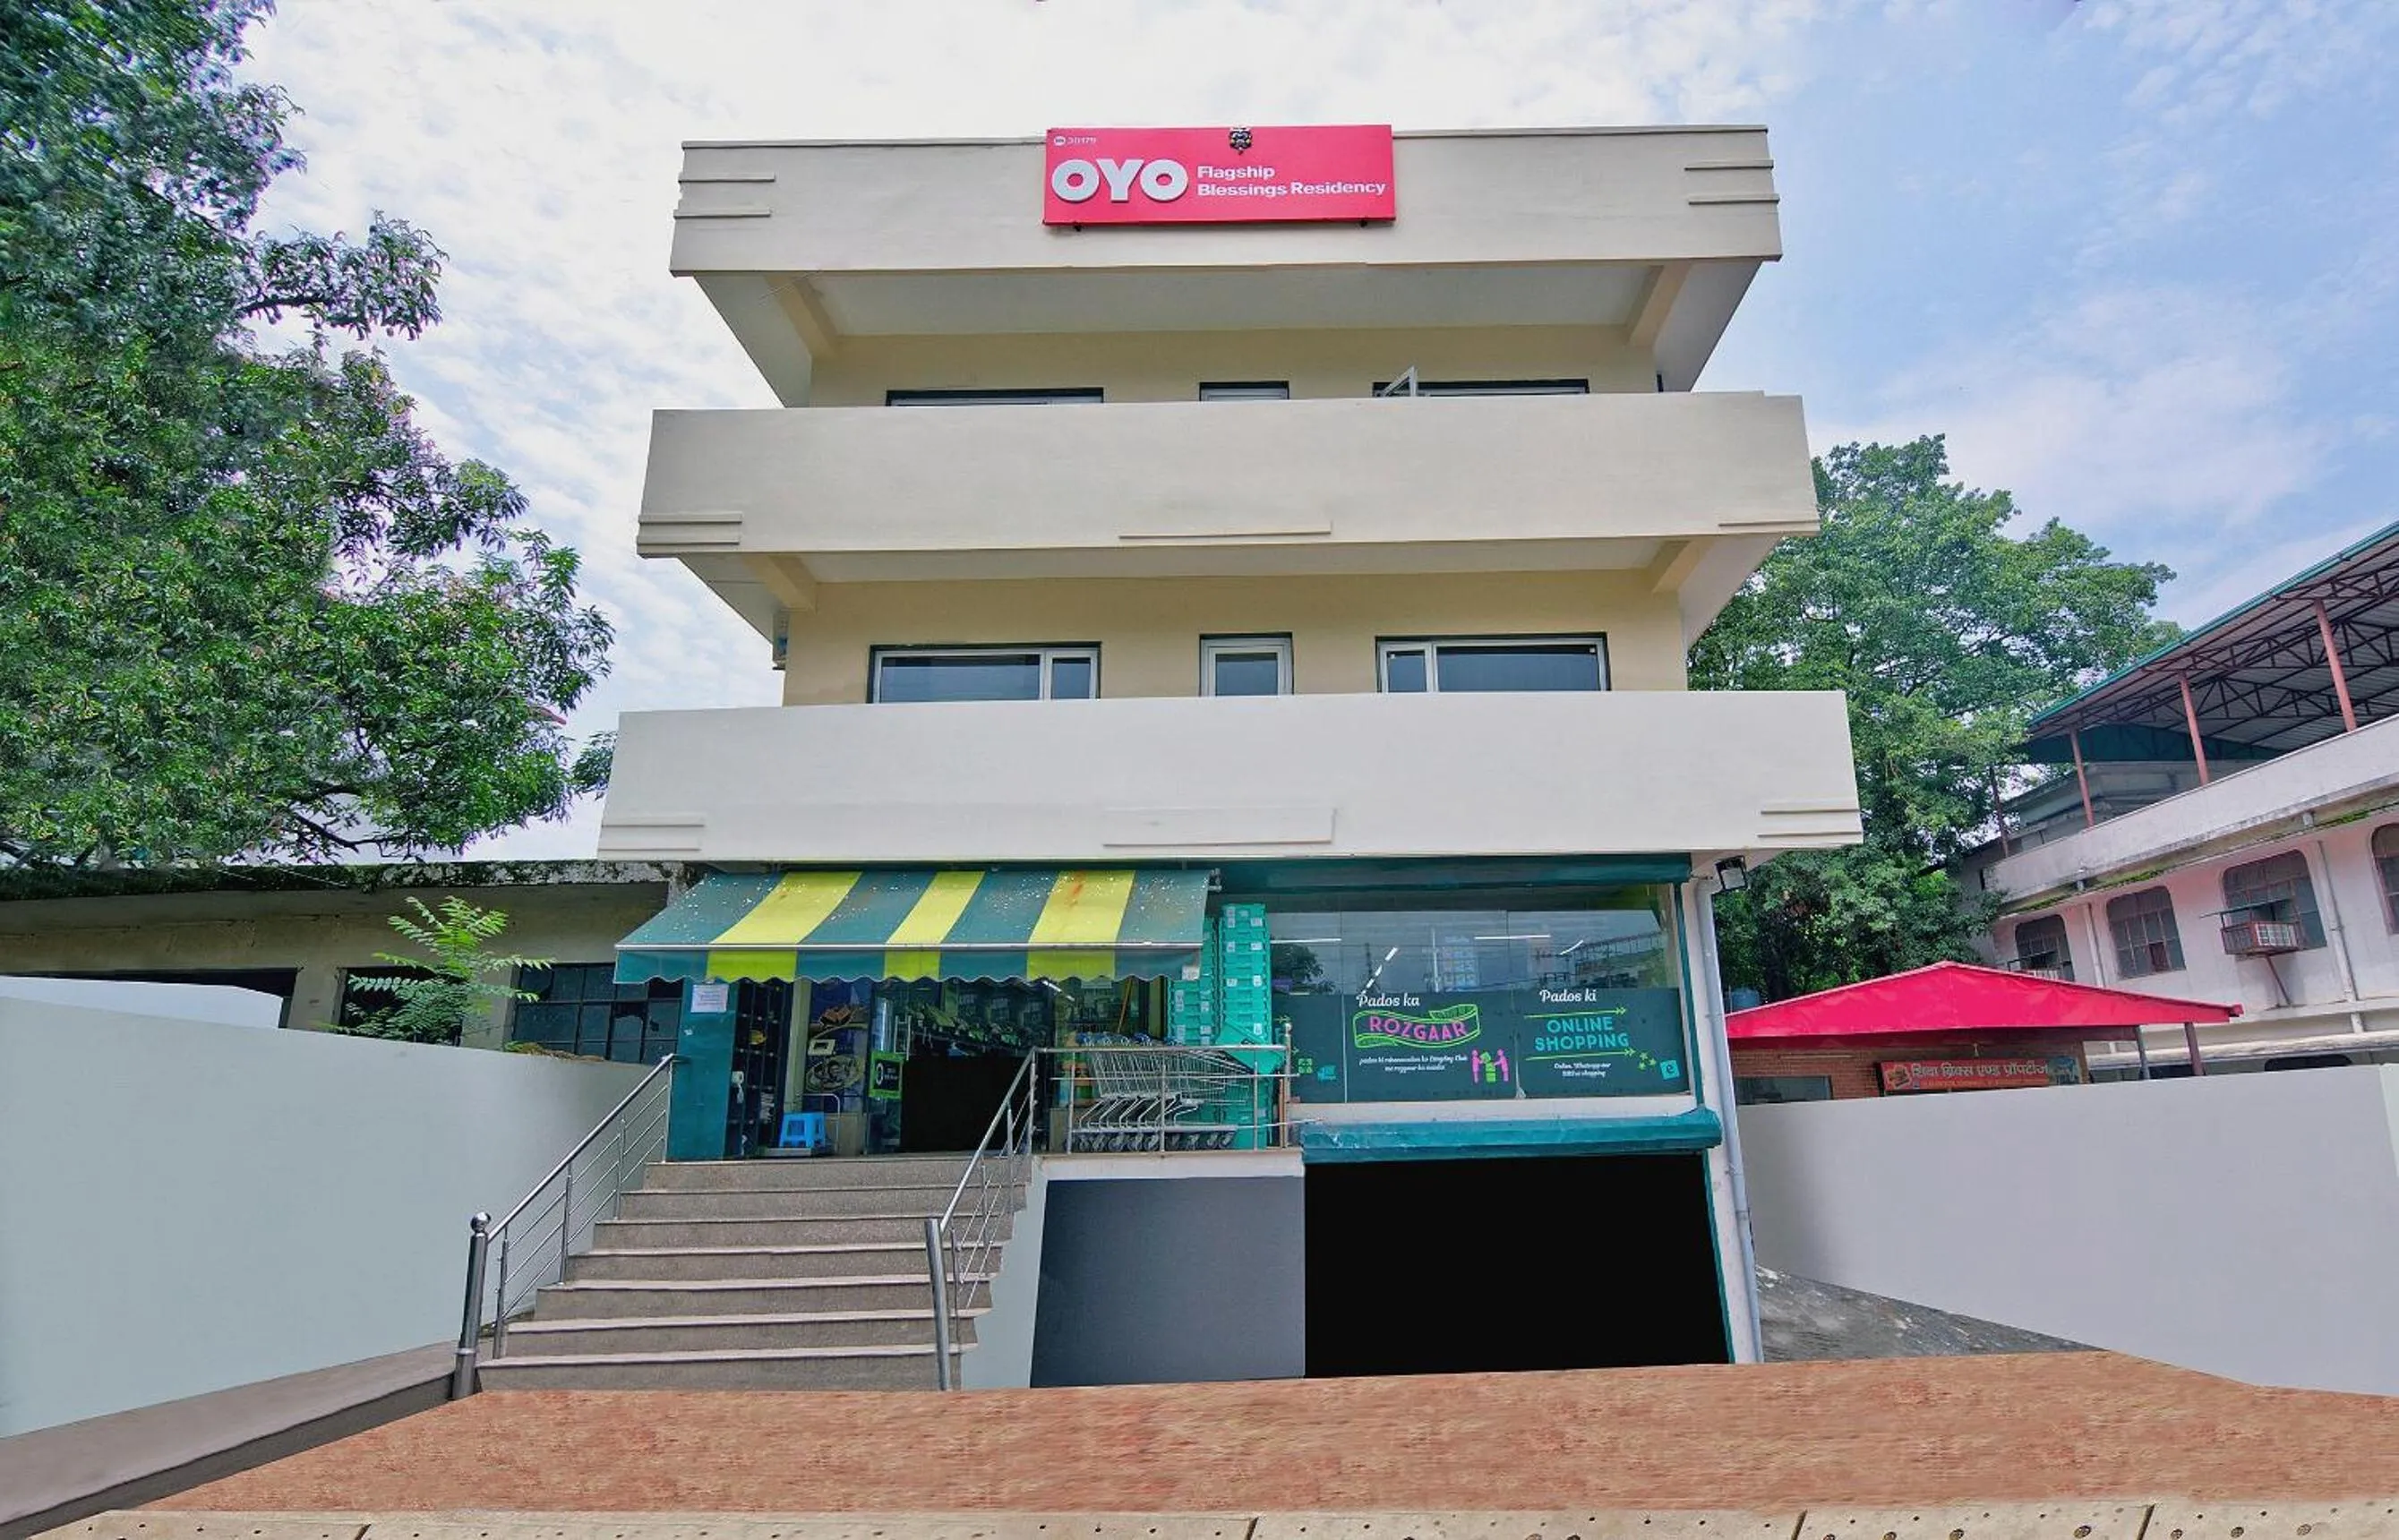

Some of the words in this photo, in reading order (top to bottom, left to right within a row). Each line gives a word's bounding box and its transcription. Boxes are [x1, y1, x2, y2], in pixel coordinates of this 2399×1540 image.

[1051, 158, 1189, 201] OYO
[1196, 166, 1275, 180] Flagship
[1196, 183, 1288, 197] Blessings
[1290, 182, 1386, 195] Residency
[1356, 992, 1401, 1007] Pados
[1403, 992, 1420, 1006] ka
[1538, 988, 1582, 1002] Pados
[1584, 988, 1597, 1002] ki
[1369, 1015, 1467, 1040] ROZGAAR
[1546, 1016, 1614, 1033] ONLINE
[1535, 1032, 1630, 1052] SHOPPING
